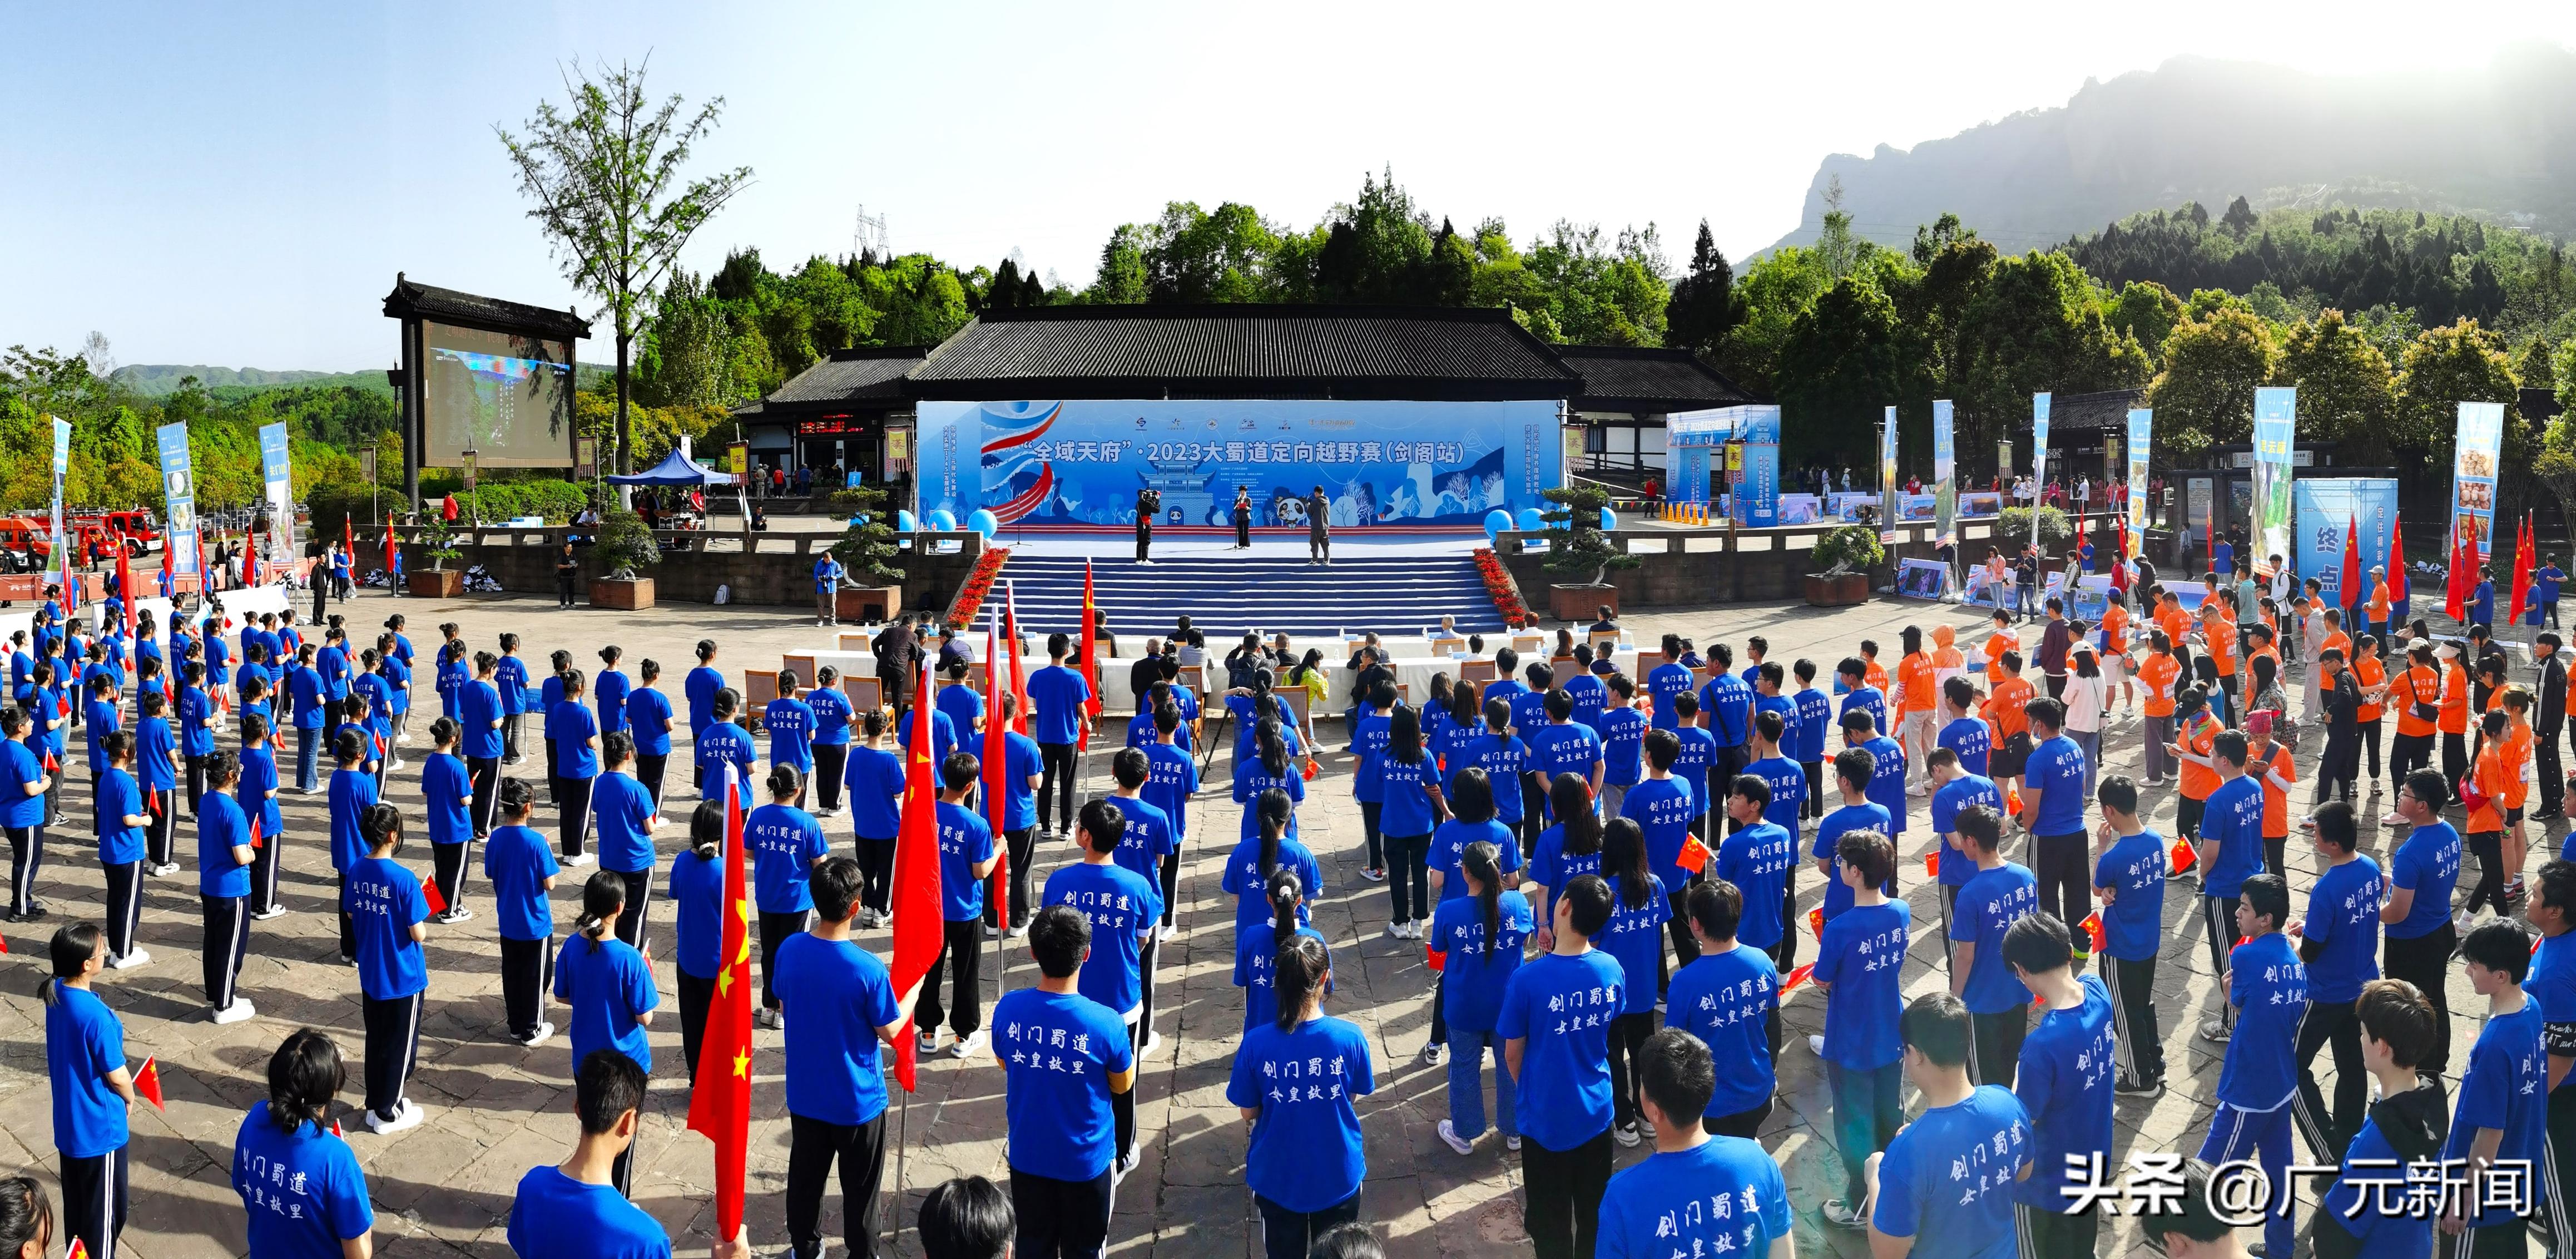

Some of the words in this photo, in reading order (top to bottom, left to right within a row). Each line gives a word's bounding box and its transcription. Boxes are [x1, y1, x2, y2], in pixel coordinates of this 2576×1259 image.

[2316, 525, 2340, 592] 终点
[1661, 674, 1692, 684] 剑门蜀道
[2413, 678, 2438, 687] 剑门蜀
[809, 699, 834, 708] 剑门蜀道
[1801, 698, 1827, 712] 剑门蜀道
[771, 710, 801, 720] 剑门蜀道
[1611, 720, 1644, 733] 剑门蜀道
[704, 737, 736, 748] 剑门蜀道
[1551, 738, 1591, 753] 剑门蜀道
[1678, 742, 1706, 754] 门蜀道
[1480, 751, 1521, 763] 剑门蜀道
[1556, 751, 1591, 763] 女皇故里
[2056, 748, 2084, 767] 剑门蜀
[1150, 762, 1182, 773] 门蜀道
[2062, 762, 2084, 778] 女皇故
[1649, 796, 1691, 812] 剑门蜀道
[1956, 789, 1994, 811] 剑门蜀道
[756, 824, 802, 841] 剑门蜀道
[759, 840, 797, 855] 女皇故里
[1747, 842, 1790, 860] 剑门蜀道
[1246, 862, 1299, 875] 剑蜀道
[1752, 860, 1789, 875] 女皇故里
[1063, 890, 1130, 911] 剑门蜀道
[1988, 882, 2037, 915] 剑门蜀道
[2263, 962, 2307, 984] 剑门蜀
[1548, 984, 1617, 1013] 剑门蜀道
[1699, 975, 1770, 1011] 剑门蜀道
[2269, 988, 2307, 1005] 女皇故
[1708, 999, 1768, 1028] 女皇故里
[1554, 1010, 1613, 1036] 女皇故里
[1007, 1021, 1091, 1055] 剑门蜀道
[2076, 1020, 2113, 1073] 剑门蜀
[1011, 1049, 1084, 1074] 女皇故里
[1262, 1056, 1345, 1079] 剑门蜀道
[1268, 1084, 1341, 1104] 女皇故里
[1949, 1119, 2023, 1182] 剑门蜀道
[1959, 1154, 2022, 1207] 女皇故里
[1656, 1184, 1761, 1239] 剑门蜀道
